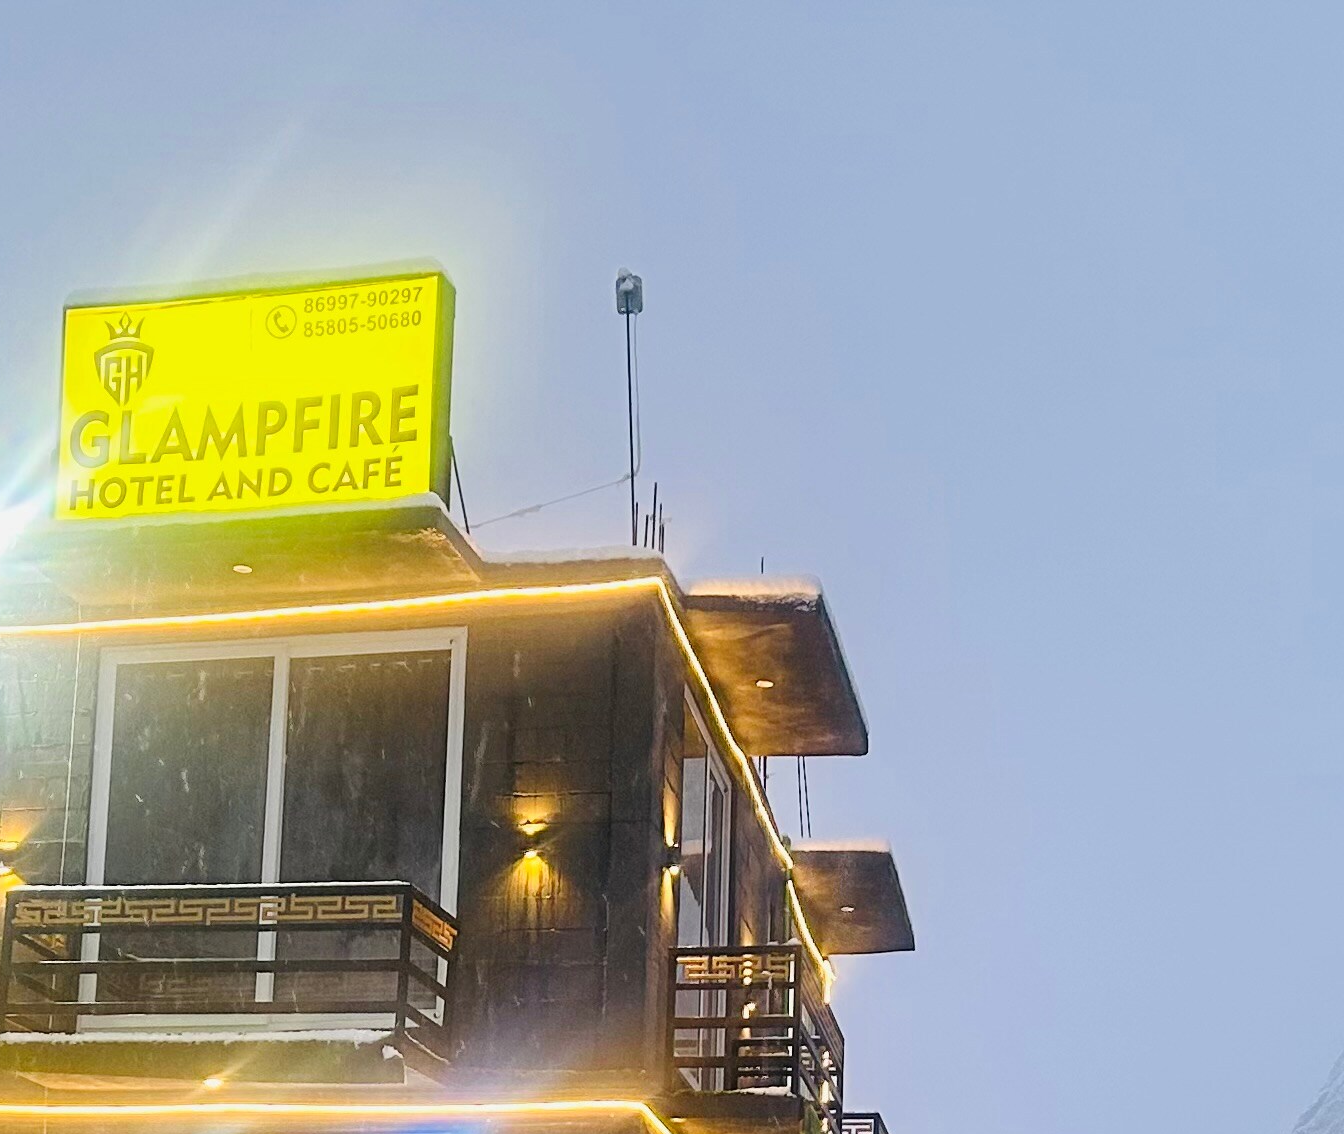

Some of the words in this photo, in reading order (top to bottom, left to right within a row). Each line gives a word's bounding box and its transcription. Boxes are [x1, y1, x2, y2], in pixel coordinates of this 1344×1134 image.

[302, 309, 423, 338] 85805-50680
[303, 286, 424, 314] 86997-90297
[69, 384, 420, 469] GLAMPFIRE
[69, 472, 196, 511] HOTEL
[207, 466, 293, 501] AND
[307, 446, 404, 494] CAFÉ
